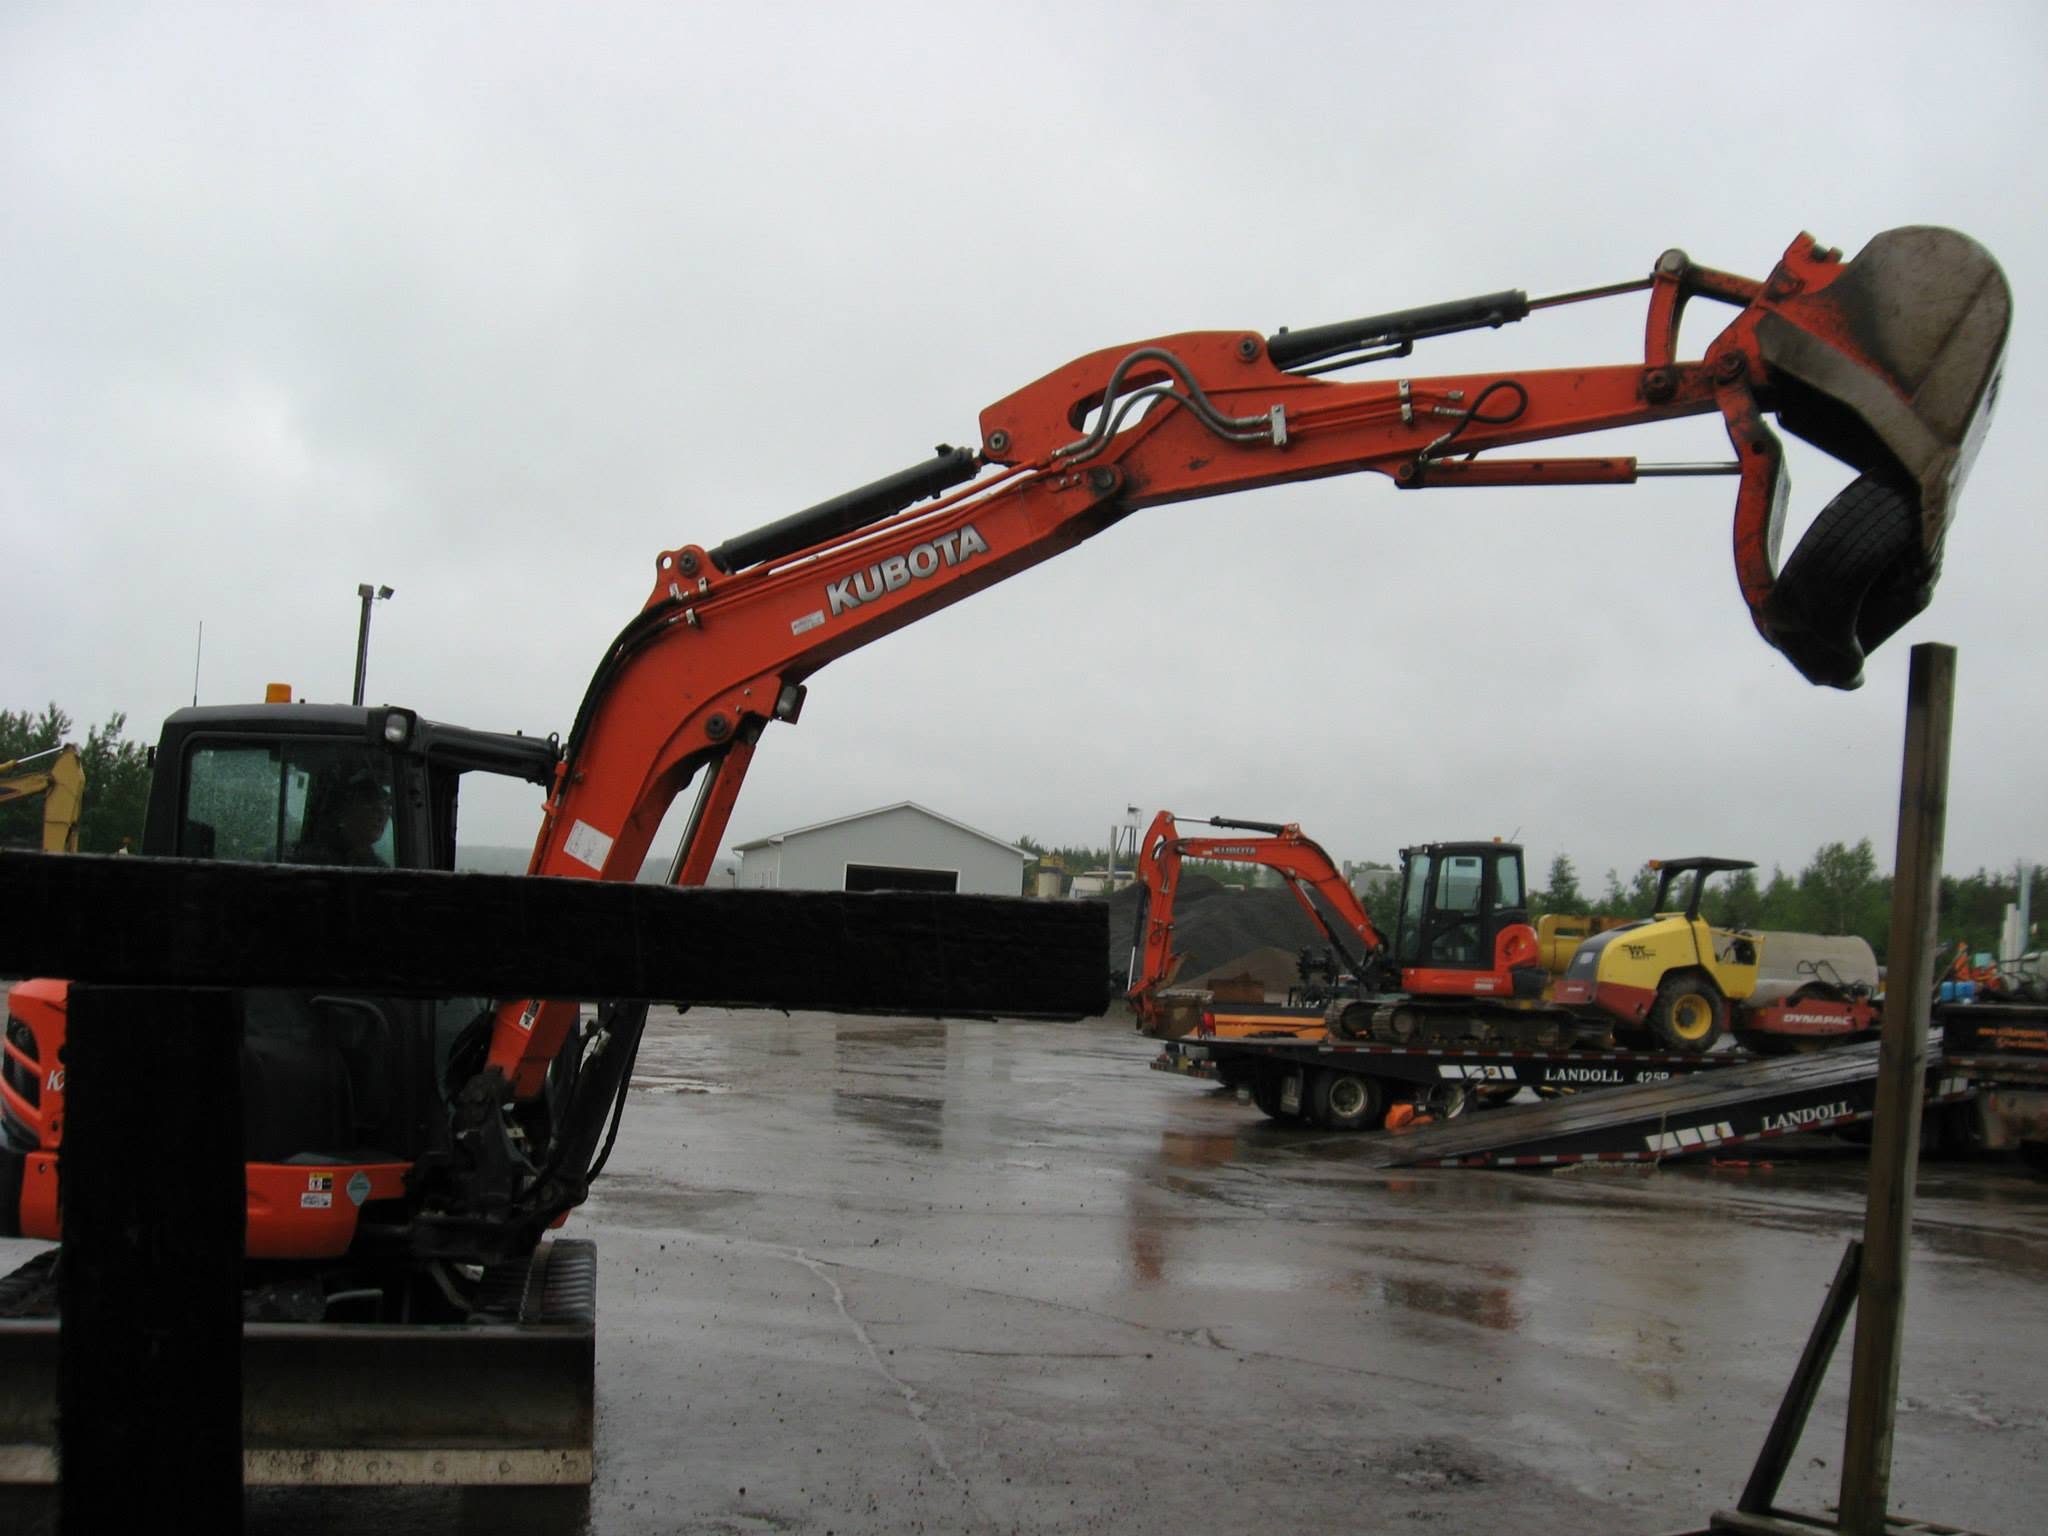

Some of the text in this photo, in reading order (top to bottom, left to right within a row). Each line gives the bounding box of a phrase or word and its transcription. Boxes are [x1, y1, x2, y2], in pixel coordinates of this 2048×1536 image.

[826, 524, 989, 615] KUBOTA
[1783, 1013, 1853, 1025] DYNAPAC
[1544, 1068, 1624, 1082] LANDOLL
[1763, 1101, 1853, 1131] LANDOLL
